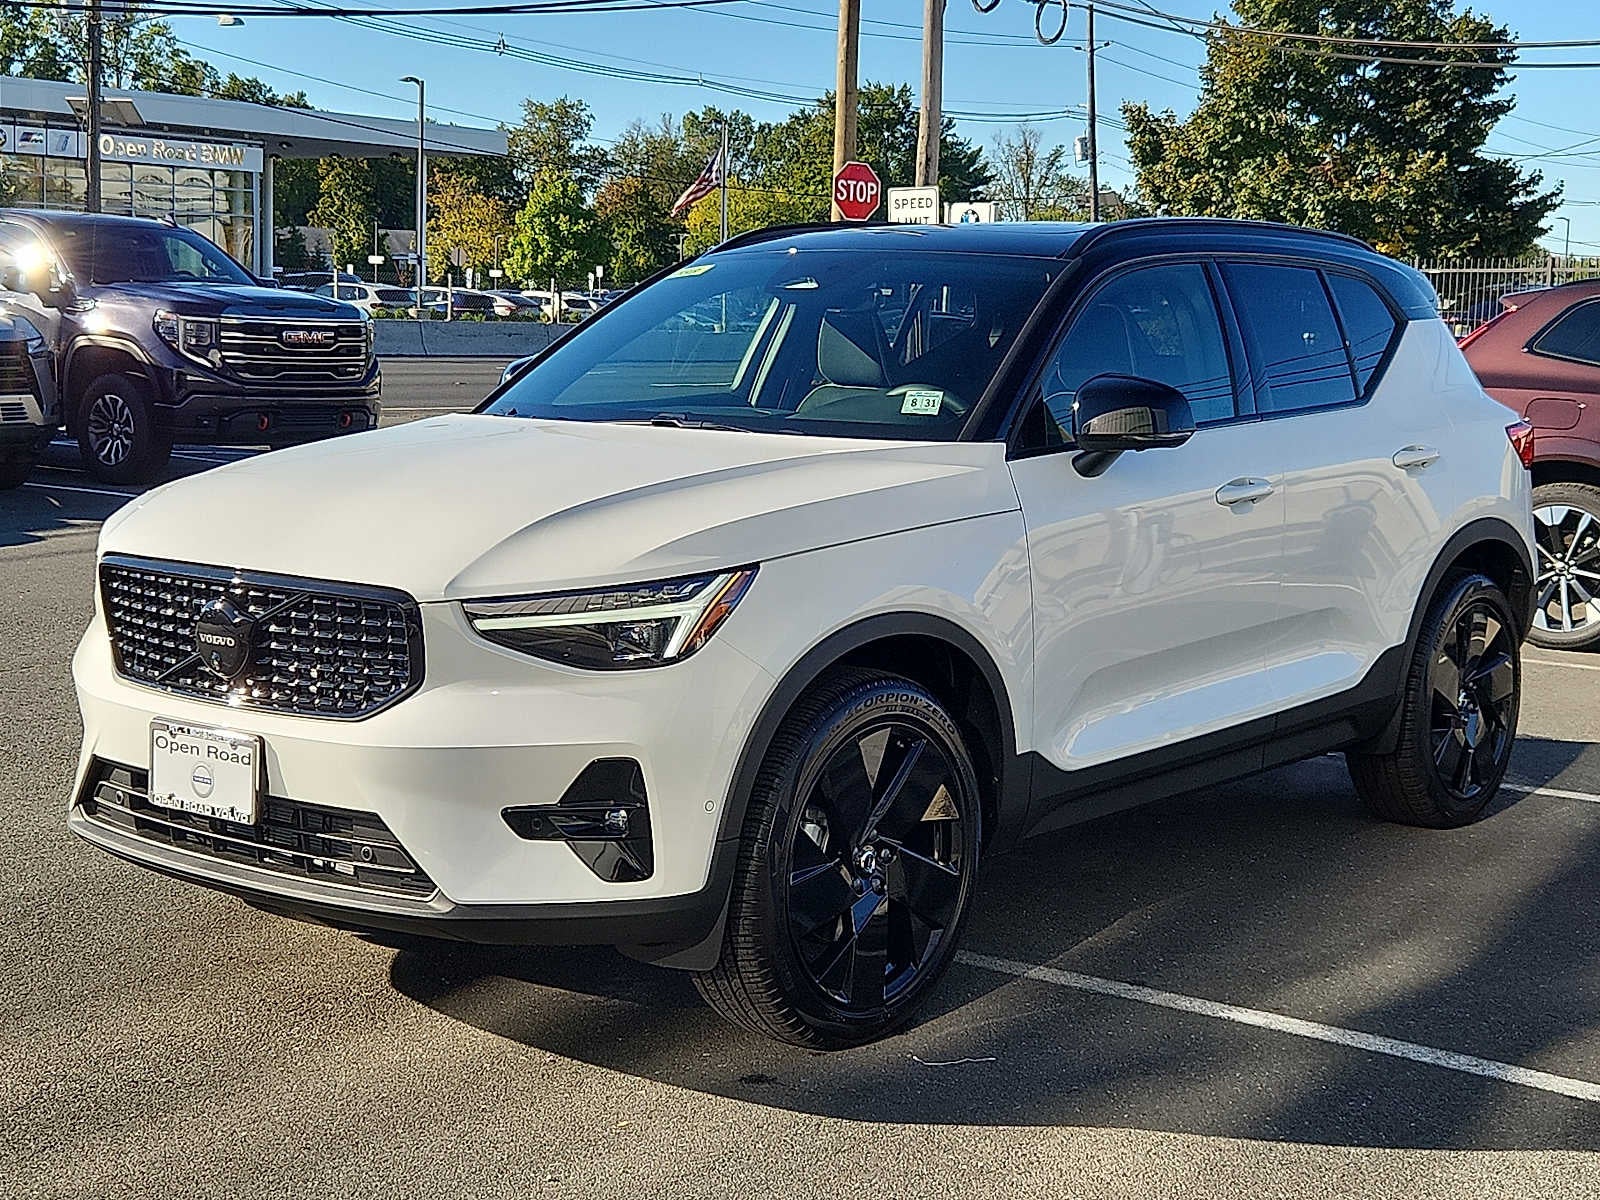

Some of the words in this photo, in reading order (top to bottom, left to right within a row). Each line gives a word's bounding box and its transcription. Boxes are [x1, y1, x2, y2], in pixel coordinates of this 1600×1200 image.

[98, 134, 147, 158] Open
[152, 139, 197, 162] Road
[200, 143, 246, 166] BMW
[836, 178, 877, 204] STOP
[894, 197, 933, 209] SPEED
[282, 330, 335, 344] GMC
[910, 398, 918, 408] 8
[924, 398, 937, 408] 31
[199, 633, 236, 647] VOLVO
[922, 701, 957, 735] ZERO
[155, 735, 200, 756] Open
[207, 745, 251, 766] Road
[184, 801, 213, 815] ROAD
[215, 807, 250, 822] VOLVO
